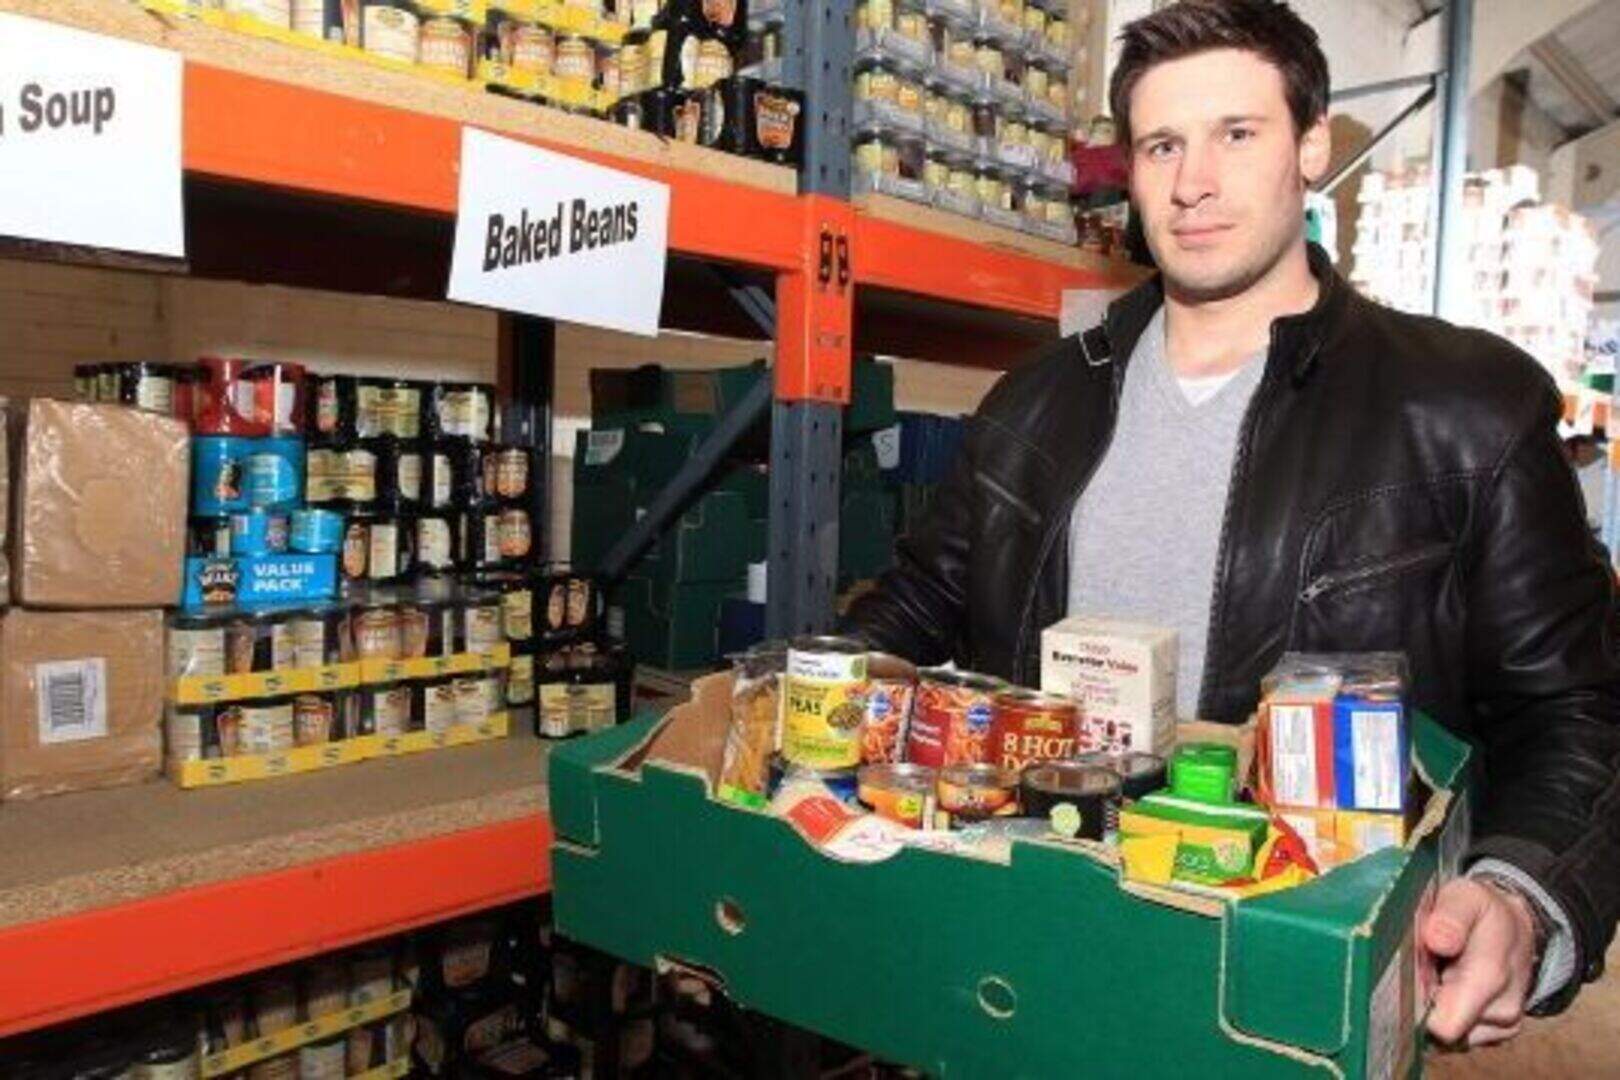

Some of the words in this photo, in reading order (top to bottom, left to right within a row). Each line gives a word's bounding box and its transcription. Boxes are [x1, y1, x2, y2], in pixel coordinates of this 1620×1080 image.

[19, 84, 115, 134] Soup
[482, 202, 564, 272] Baked
[569, 199, 638, 254] Beans
[253, 578, 302, 592] PACK
[1003, 733, 1019, 753] 8
[1022, 735, 1074, 759] HOT
